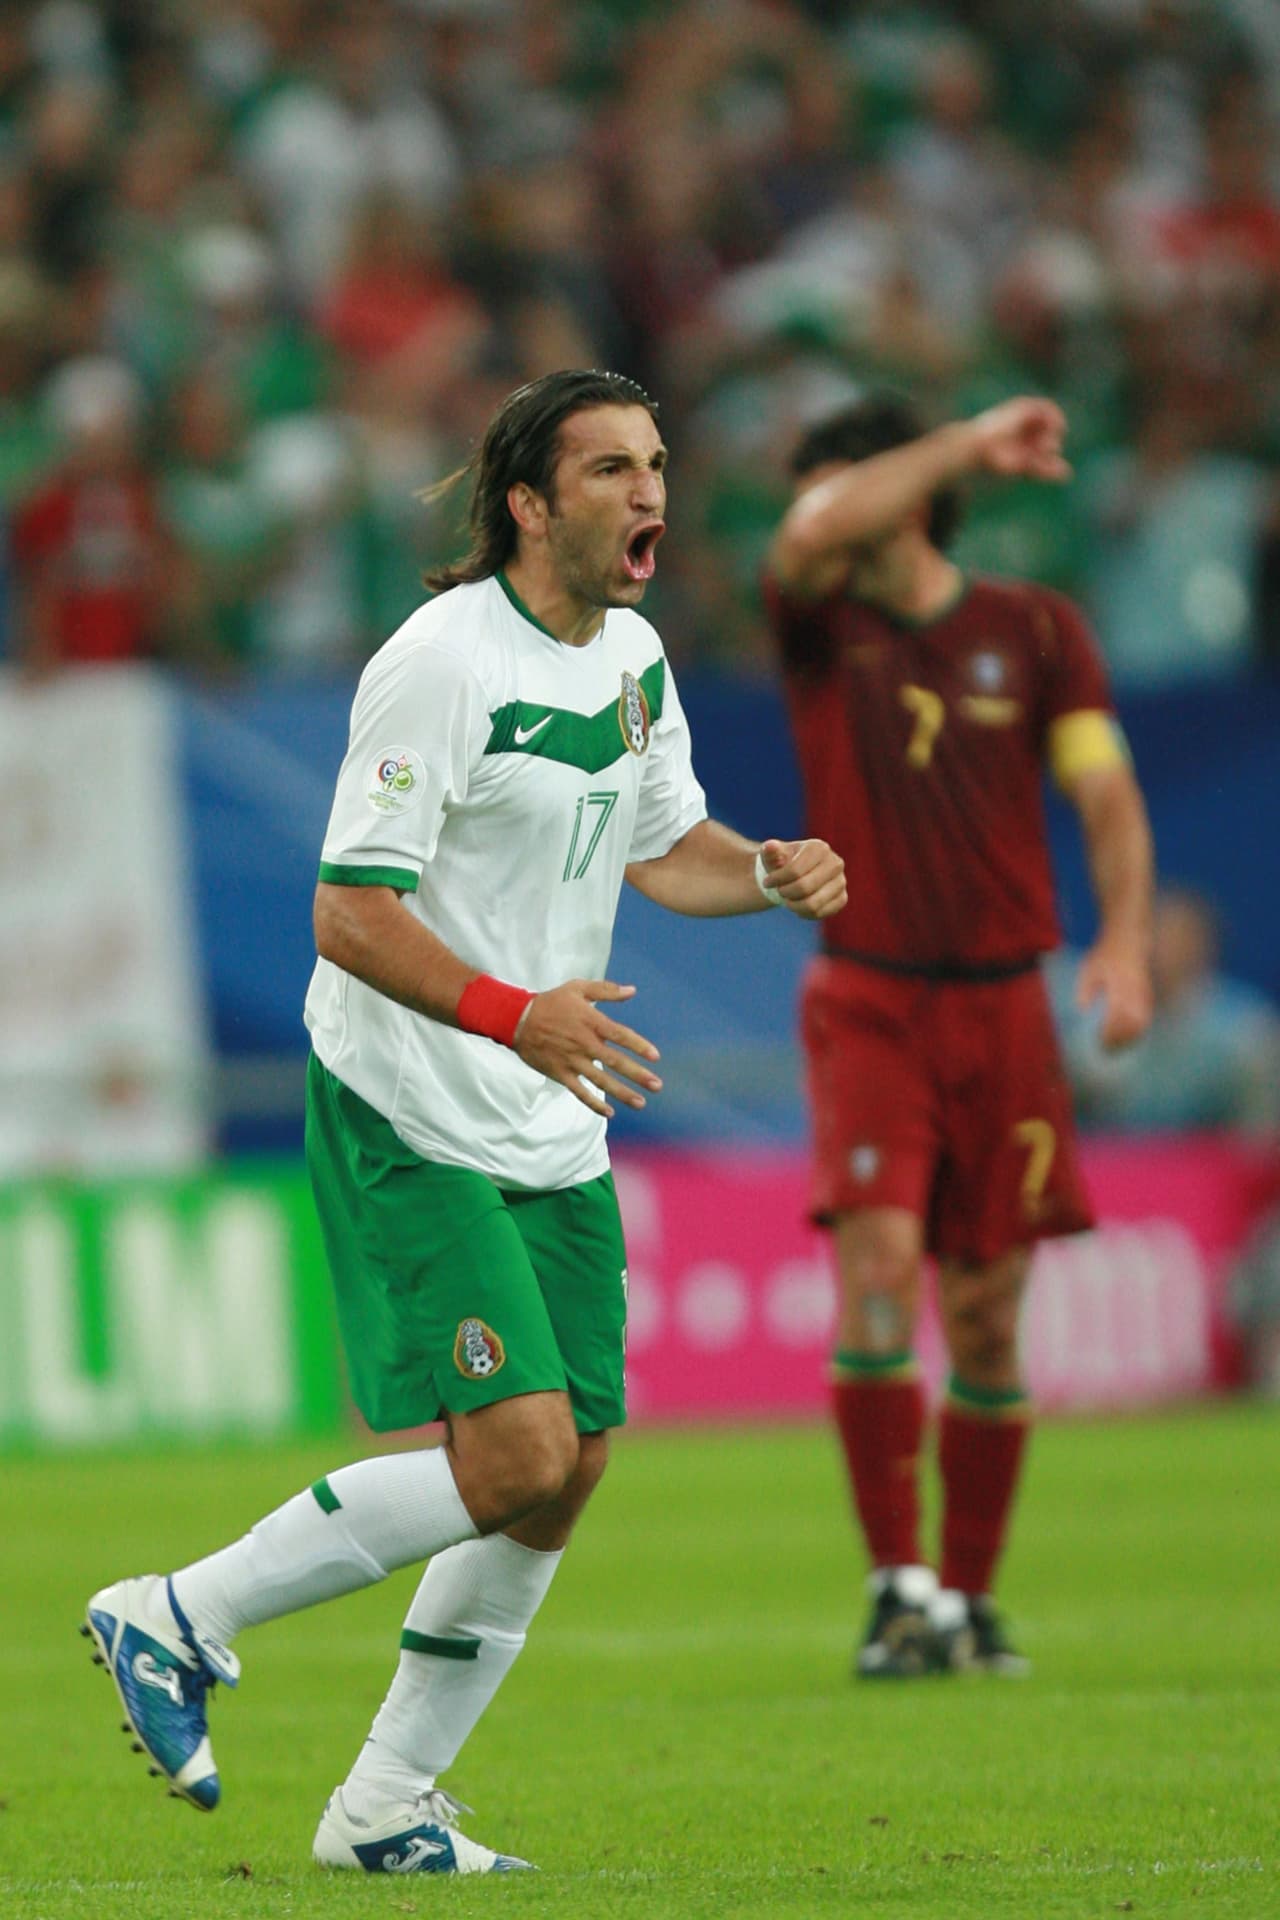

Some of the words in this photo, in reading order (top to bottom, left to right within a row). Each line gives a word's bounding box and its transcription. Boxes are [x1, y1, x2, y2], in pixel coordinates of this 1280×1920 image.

[902, 682, 946, 772] 7
[562, 790, 620, 882] 17
[1011, 1117, 1057, 1221] 7
